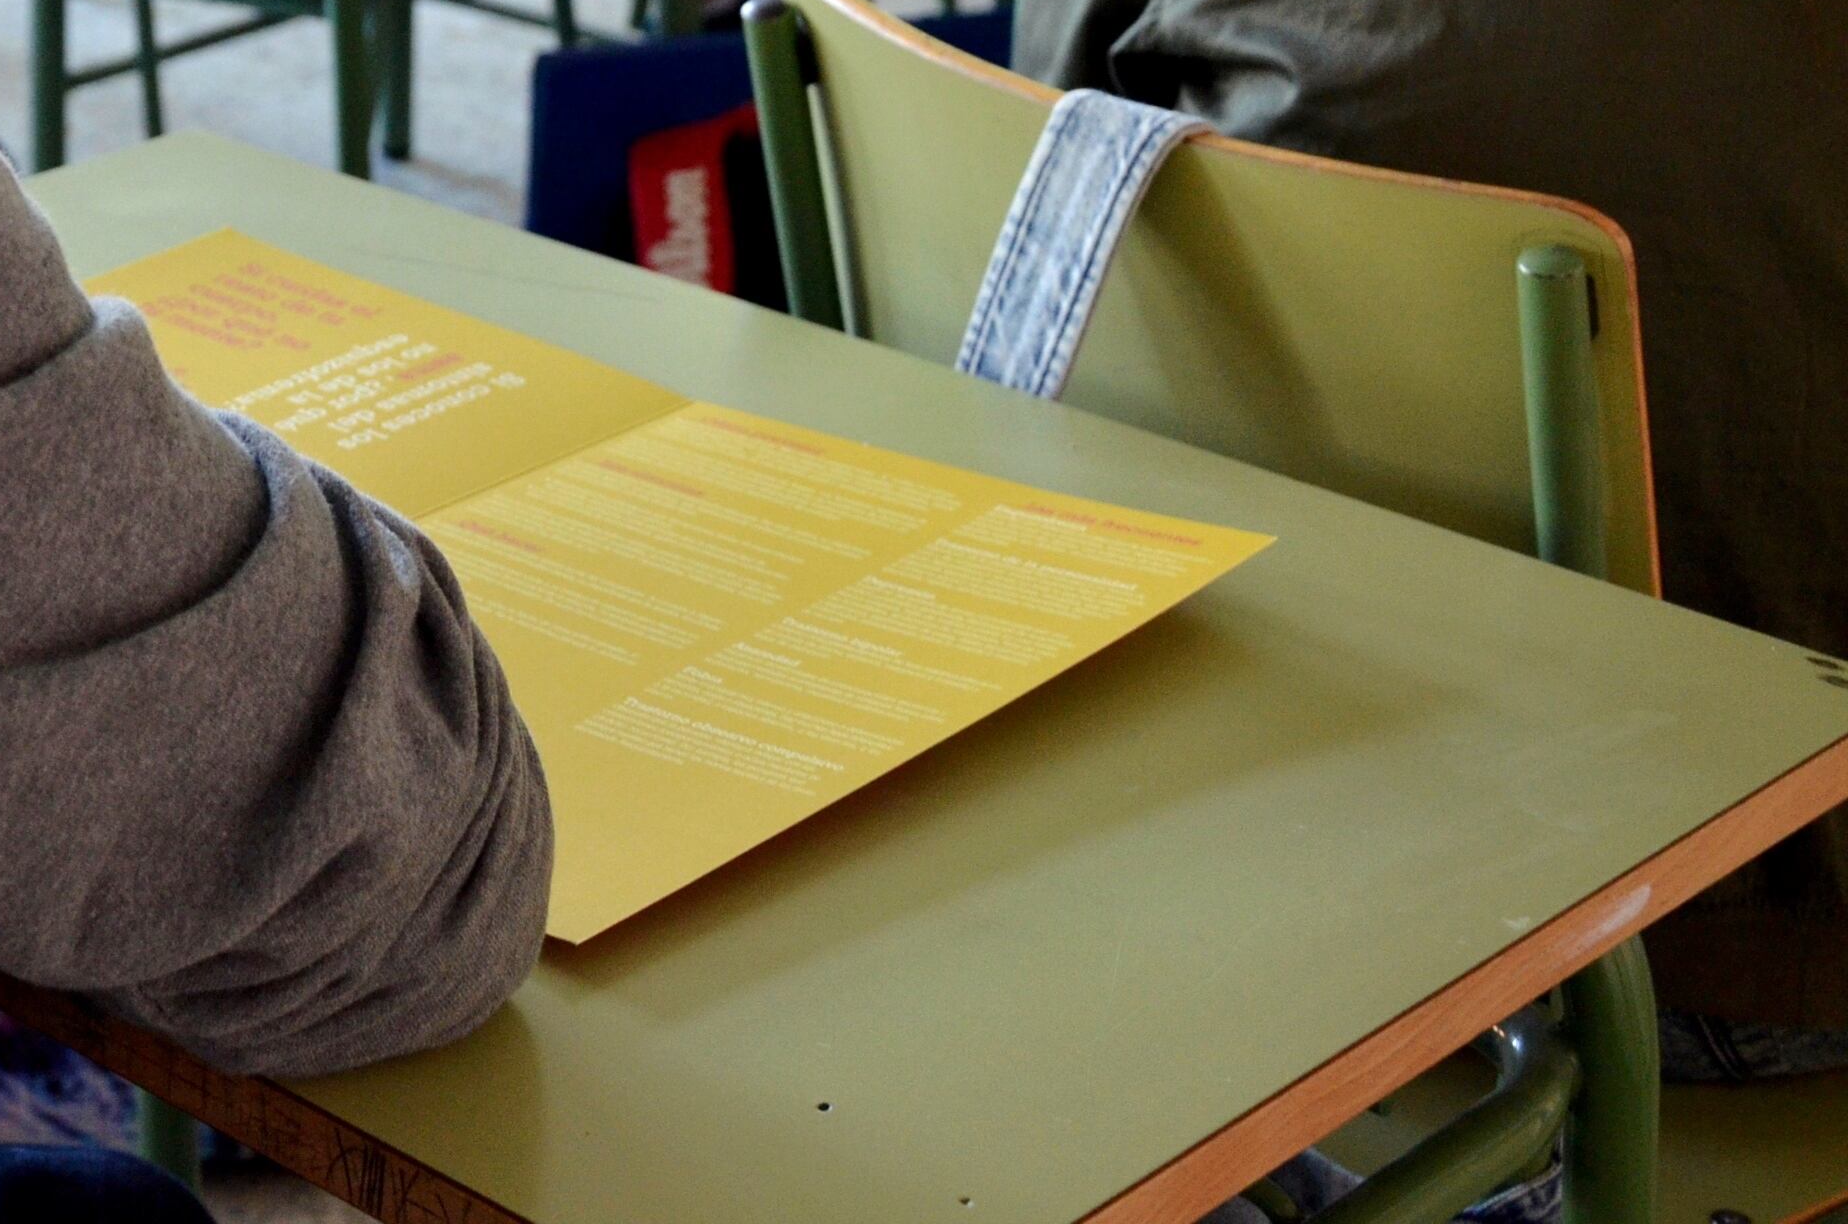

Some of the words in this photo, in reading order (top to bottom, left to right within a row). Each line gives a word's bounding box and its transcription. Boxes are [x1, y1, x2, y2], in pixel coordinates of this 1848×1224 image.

[400, 342, 439, 360] no
[356, 356, 407, 376] los
[317, 374, 357, 393] de
[286, 389, 324, 405] la
[382, 384, 491, 431] conoces
[328, 409, 376, 433] del
[337, 428, 389, 450] los
